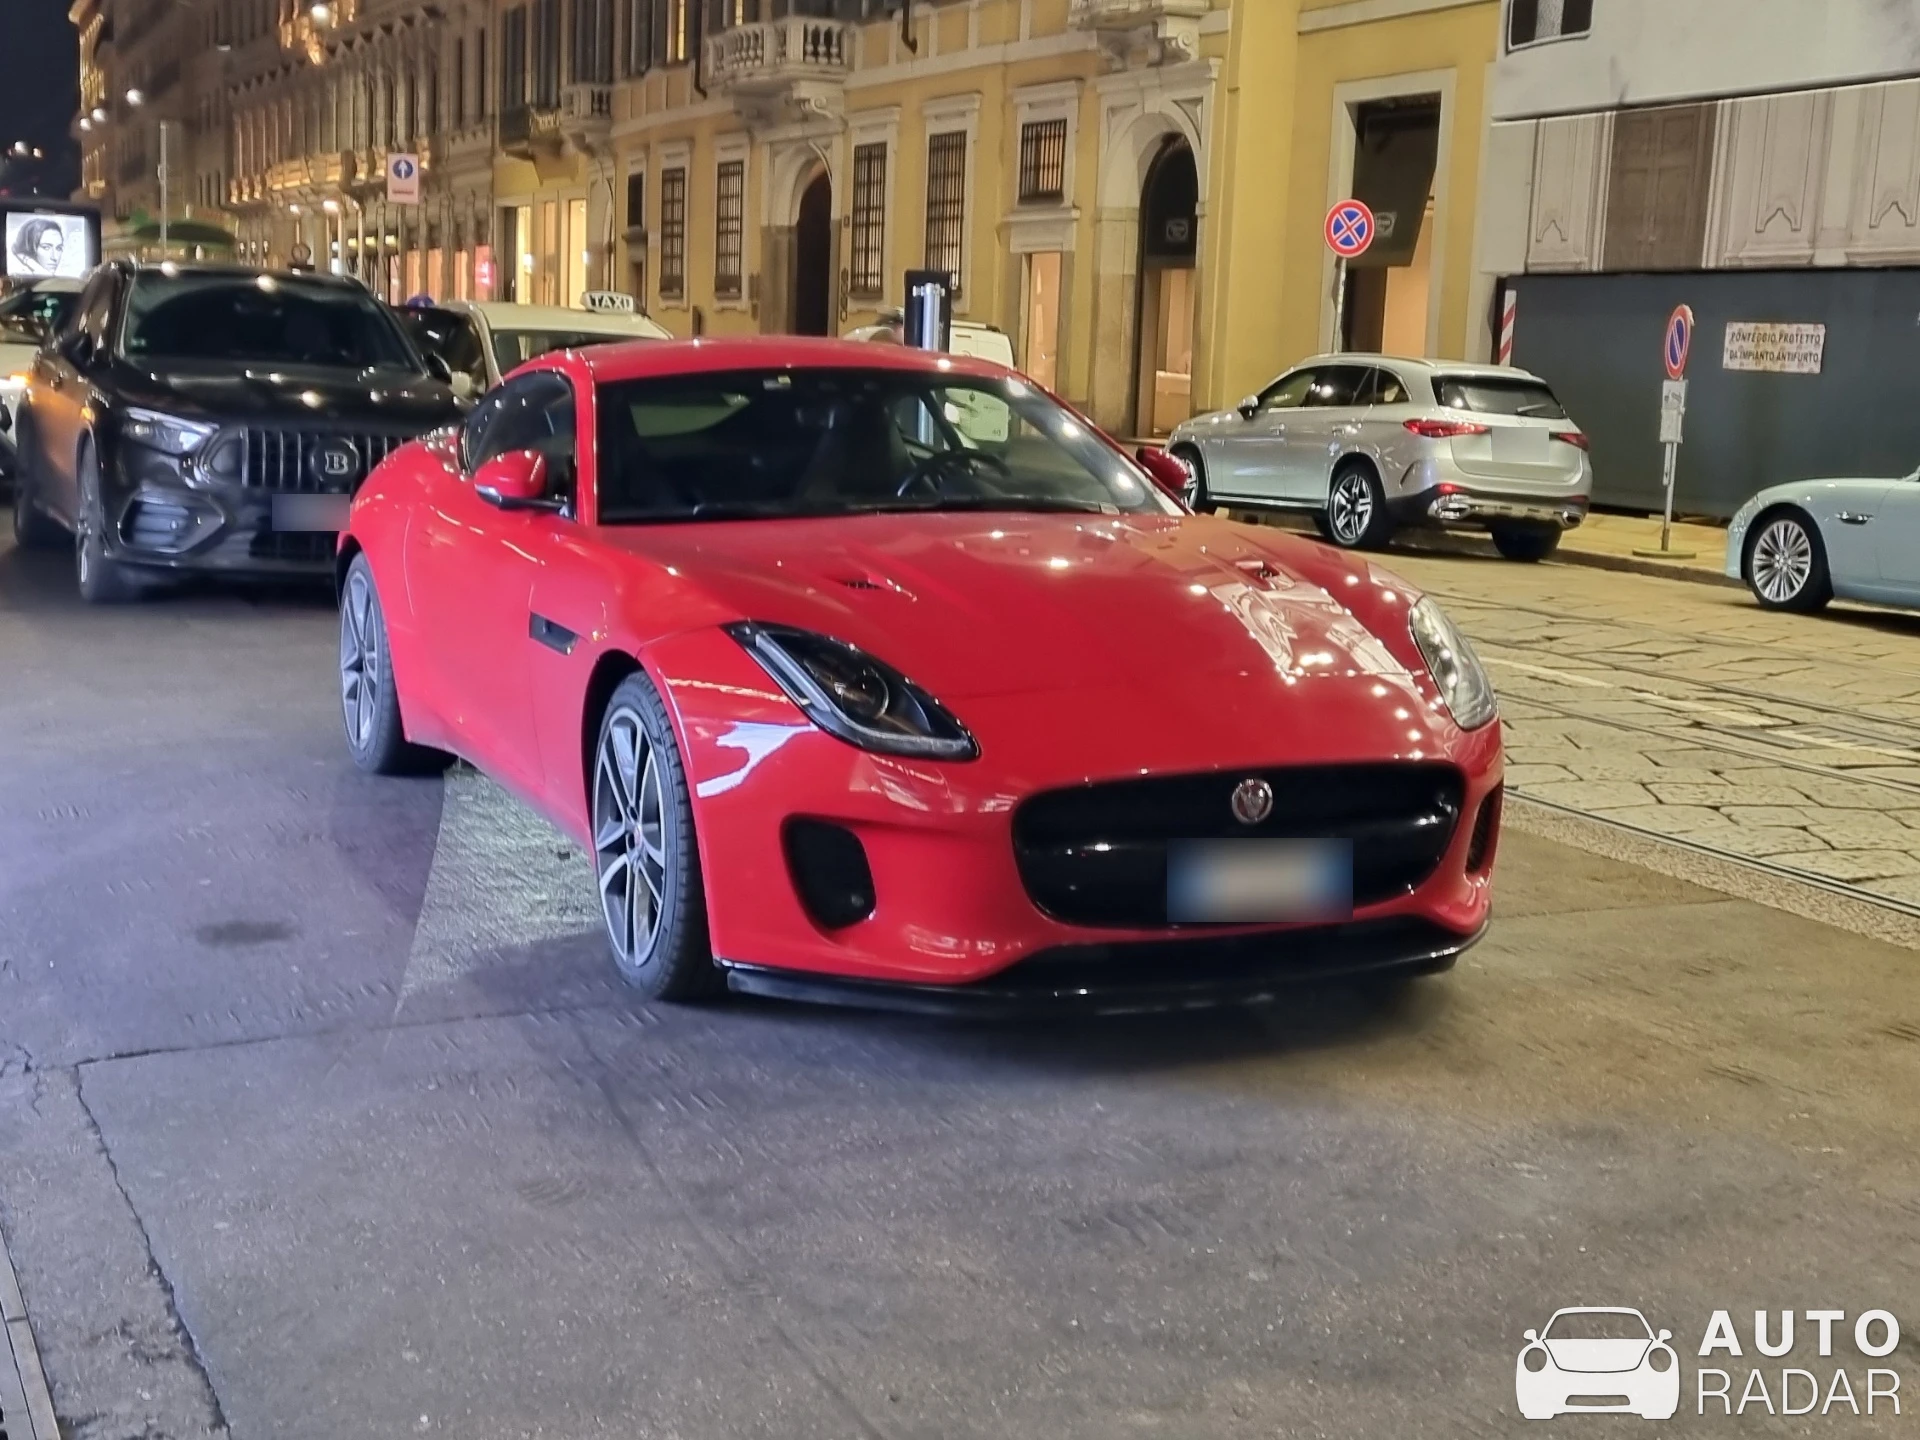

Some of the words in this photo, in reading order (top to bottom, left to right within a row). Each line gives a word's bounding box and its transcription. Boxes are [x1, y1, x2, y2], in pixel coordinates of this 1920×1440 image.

[588, 293, 631, 310] TAXI
[1731, 332, 1776, 343] PONTEGGIO
[1778, 333, 1820, 345] PROTETTO
[1729, 350, 1738, 360] DA
[1740, 350, 1775, 361] IMPIANTO
[1776, 352, 1819, 363] ANTIFURTO
[325, 451, 348, 475] B
